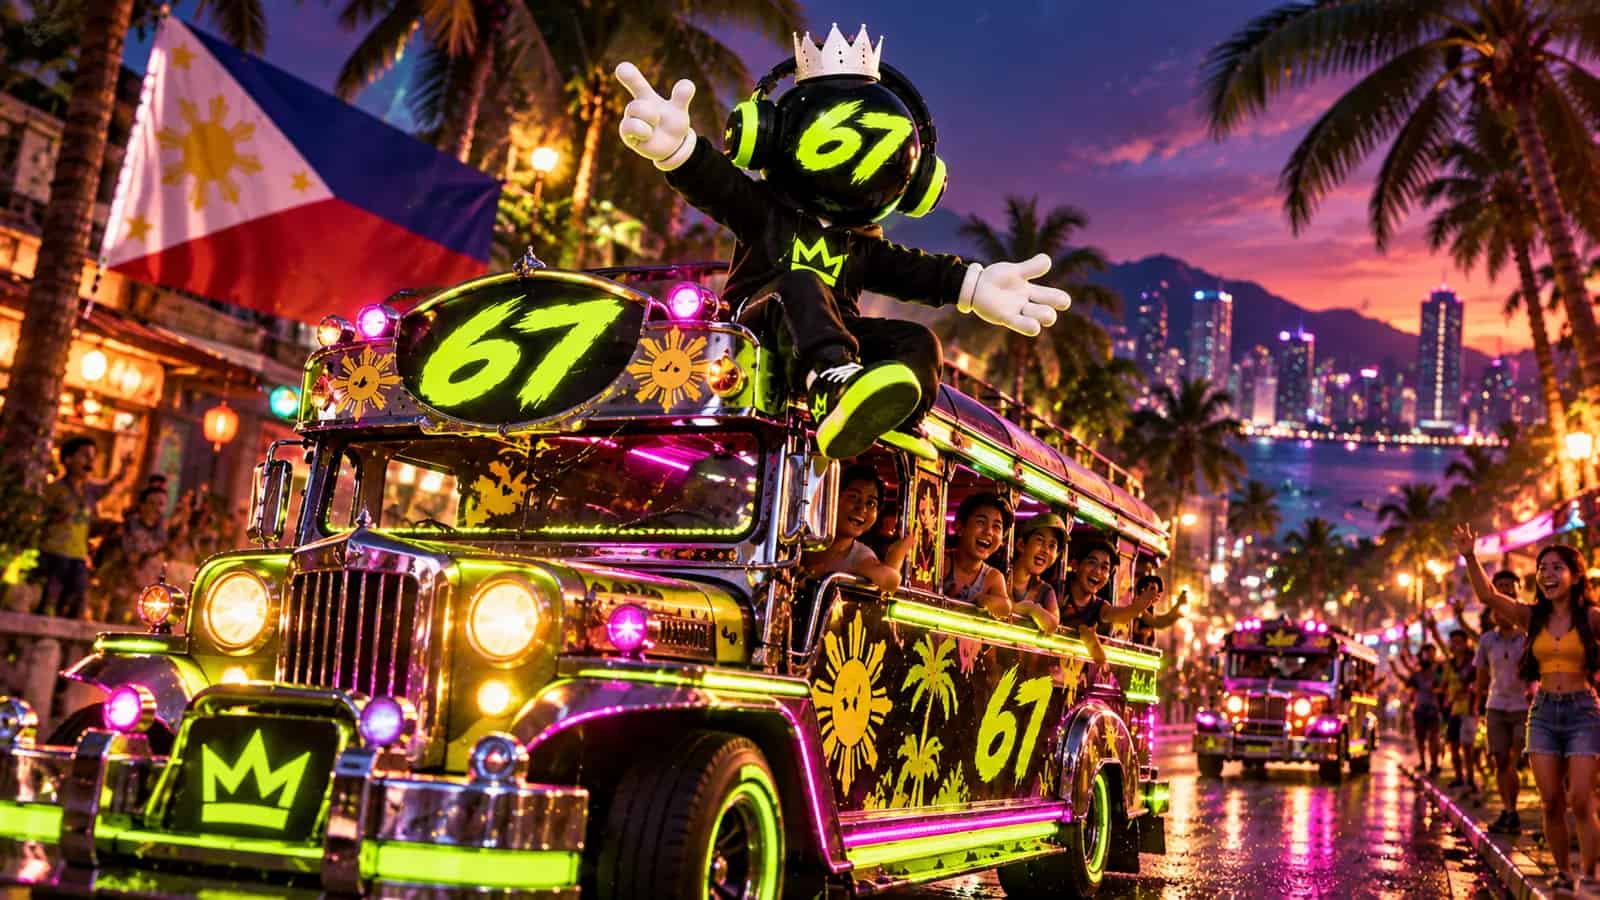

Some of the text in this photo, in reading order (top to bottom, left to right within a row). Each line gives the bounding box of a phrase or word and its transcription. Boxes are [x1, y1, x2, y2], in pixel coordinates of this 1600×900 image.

[795, 99, 914, 185] 67
[419, 295, 625, 412] 67
[975, 664, 1053, 789] 67
